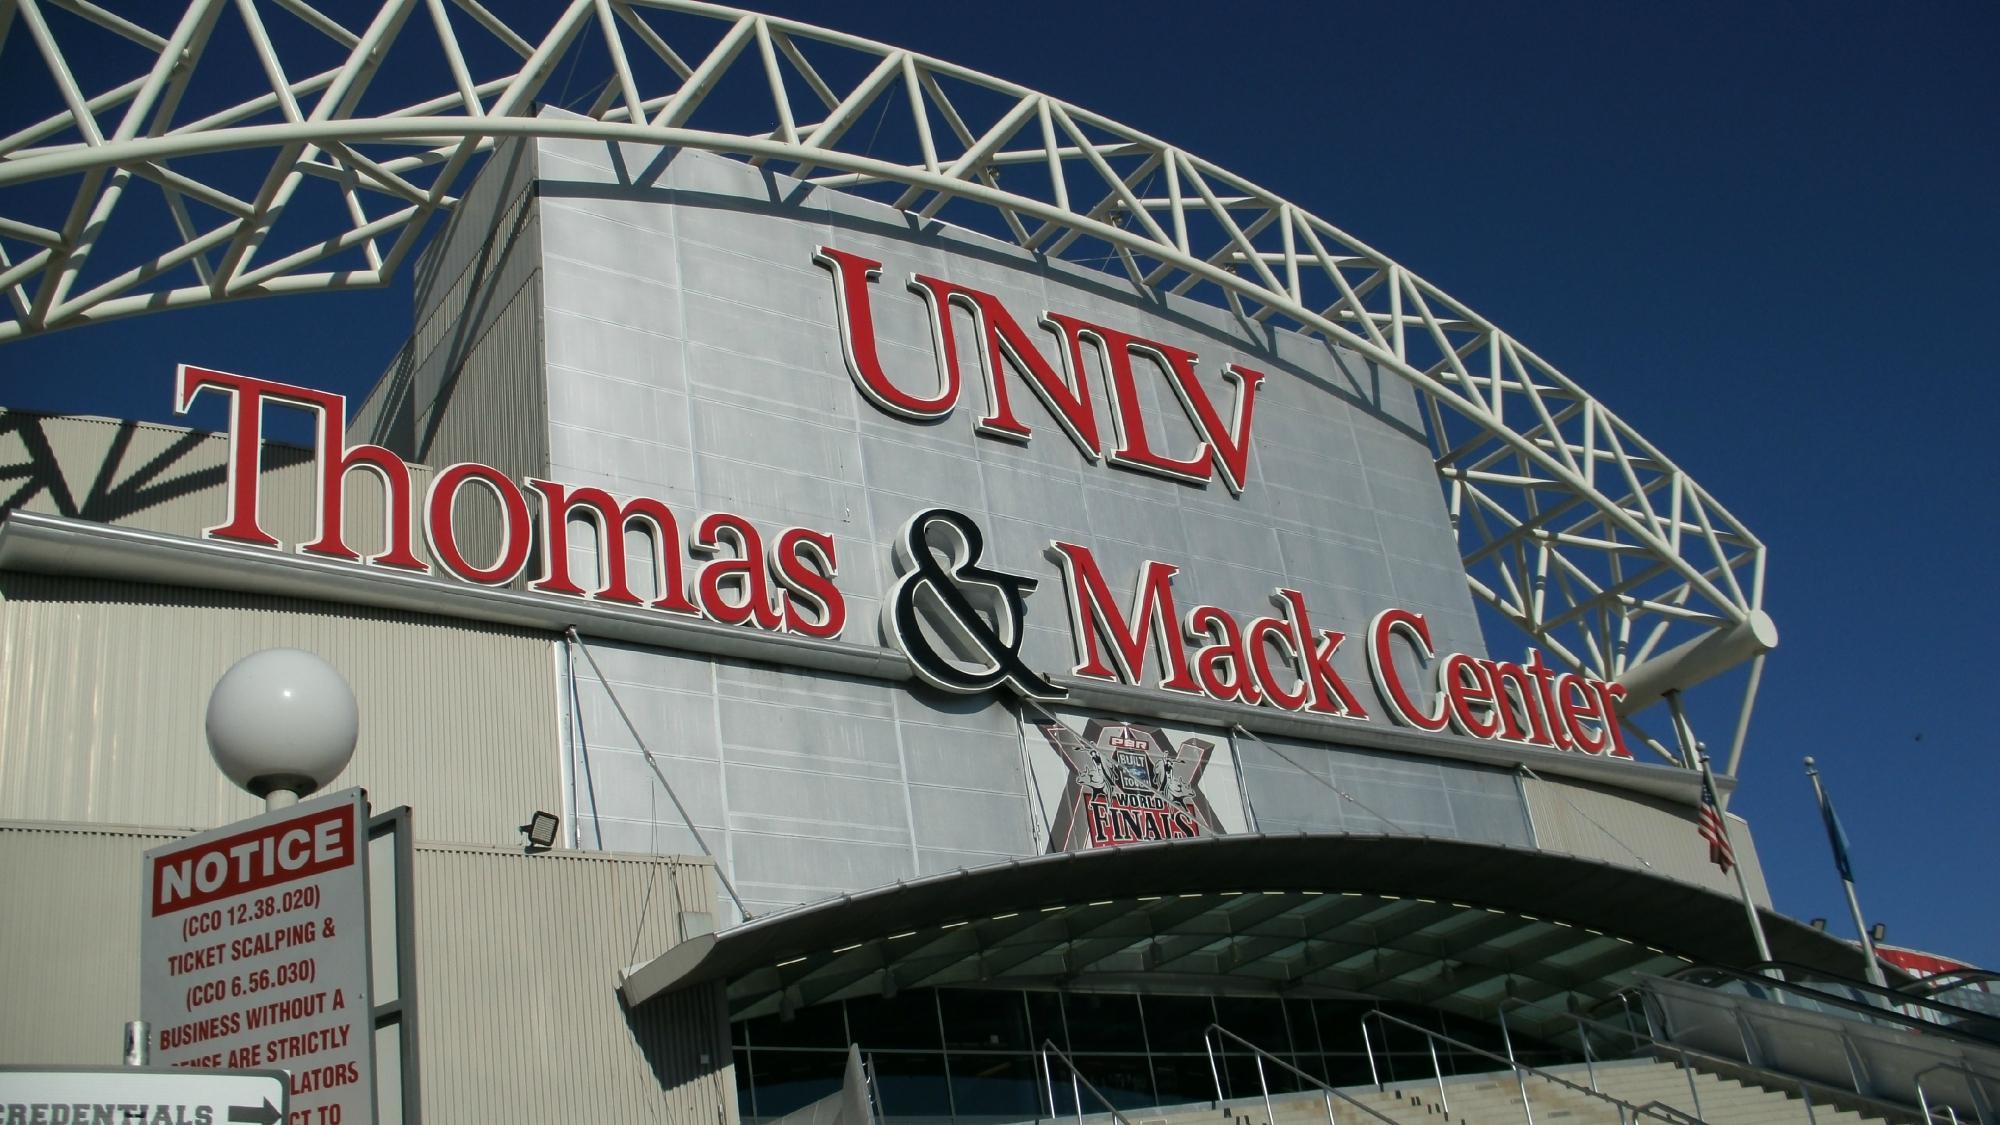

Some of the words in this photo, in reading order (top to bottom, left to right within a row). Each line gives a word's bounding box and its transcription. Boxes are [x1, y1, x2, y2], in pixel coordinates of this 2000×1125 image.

[812, 245, 1265, 494] UNLV
[175, 364, 847, 639] Thomas
[882, 508, 1069, 699] &
[1050, 539, 1369, 720] Mack
[1368, 608, 1633, 760] Center
[1120, 753, 1145, 768] BUILT
[1090, 801, 1195, 841] FINALS
[1117, 793, 1164, 809] WORLD
[161, 818, 344, 905] NOTICE
[183, 909, 222, 942] (CCO
[227, 885, 320, 926] 12.38.020)
[168, 944, 226, 976] TICKET
[231, 921, 316, 961] SCALPING
[322, 916, 336, 939] &
[186, 980, 226, 1012] (CCO
[231, 958, 315, 997] 6.56.030)
[160, 1012, 241, 1050] BUSINESS
[246, 993, 326, 1030] WITHOUT
[332, 988, 345, 1011] A
[228, 1044, 261, 1069] ARE
[267, 1024, 350, 1062] STRICTLY
[290, 1061, 359, 1096] LATORS
[0, 1103, 213, 1125] REDENTIALS
[318, 1103, 341, 1125] TO
